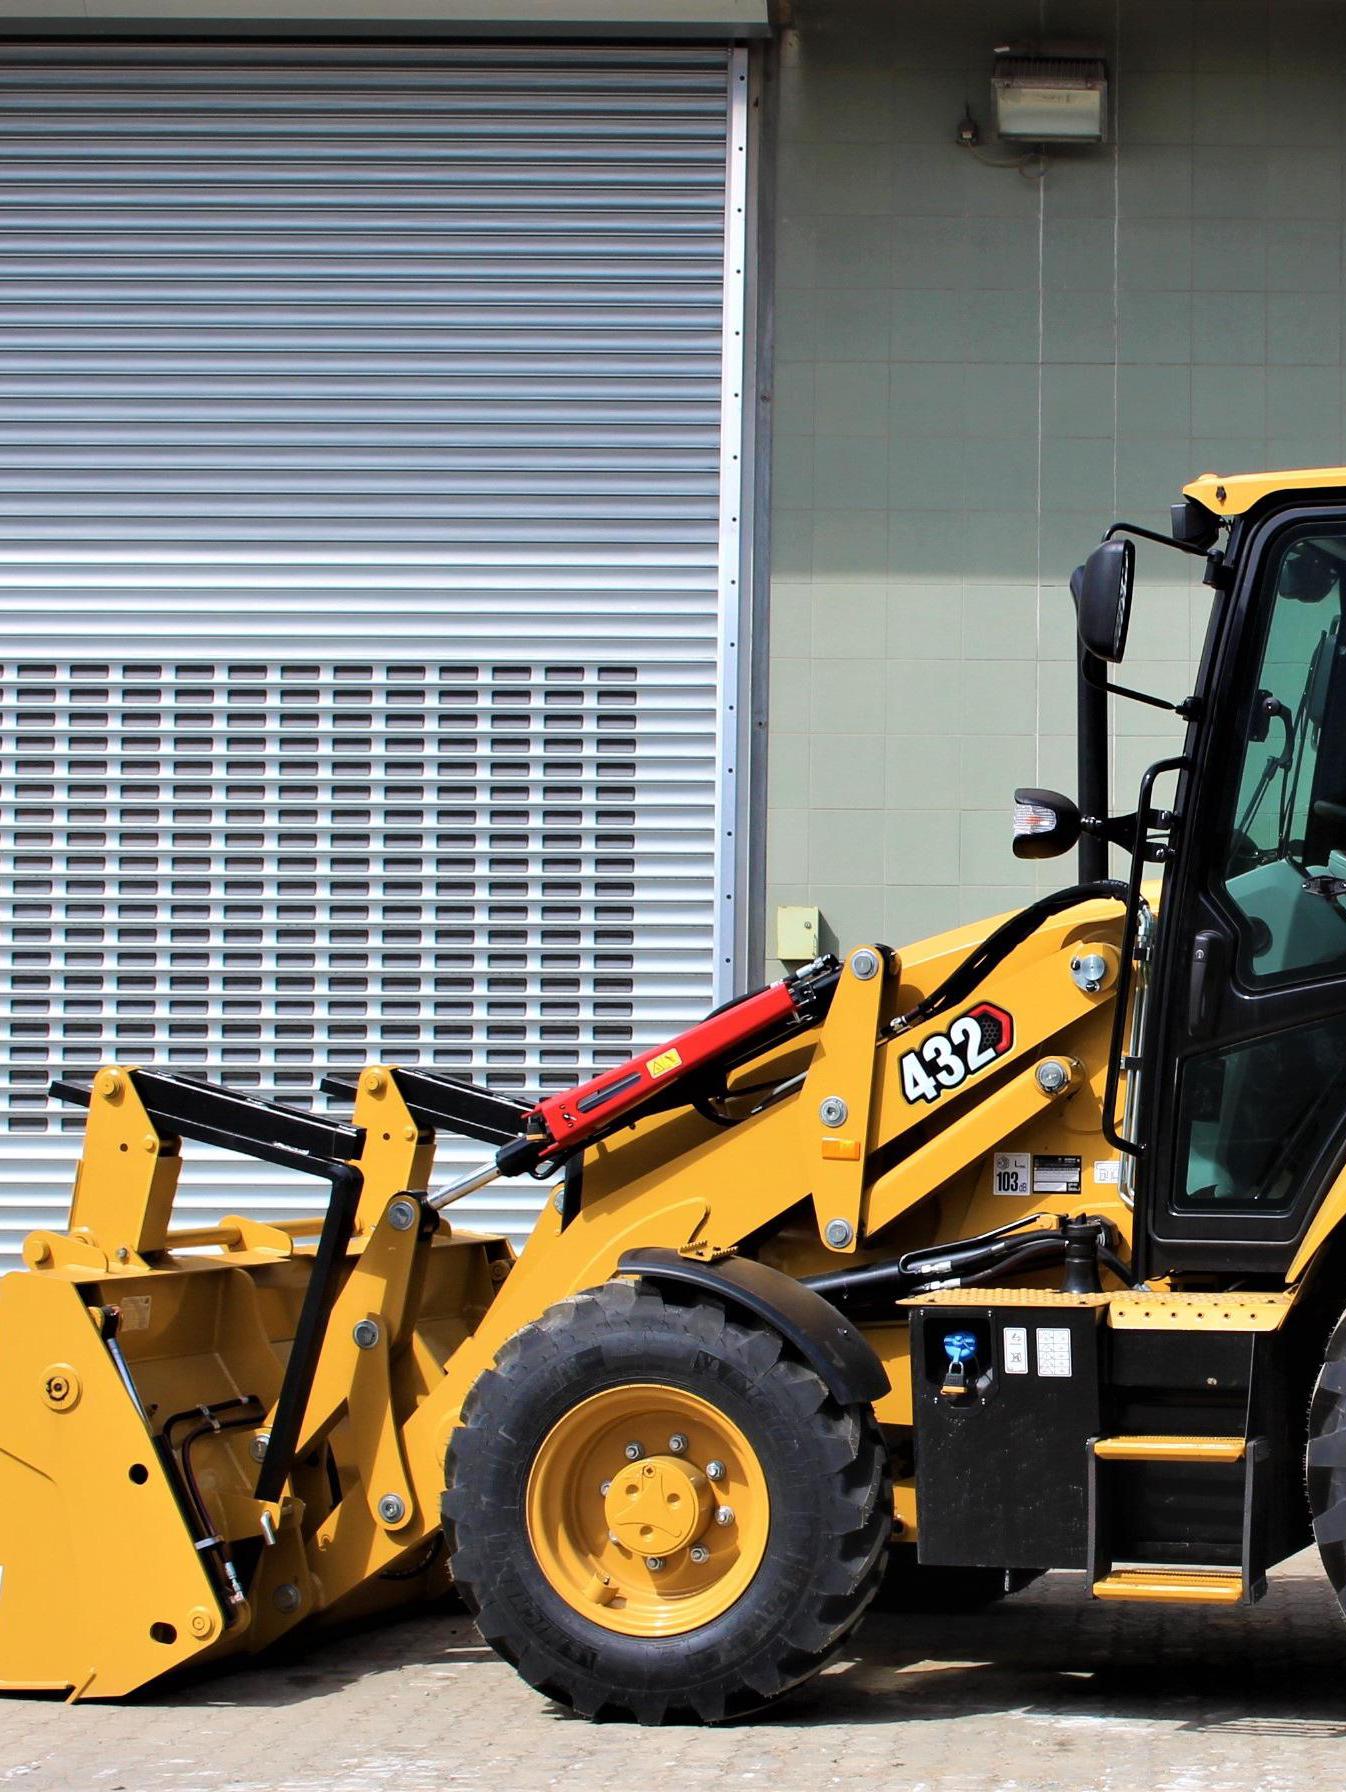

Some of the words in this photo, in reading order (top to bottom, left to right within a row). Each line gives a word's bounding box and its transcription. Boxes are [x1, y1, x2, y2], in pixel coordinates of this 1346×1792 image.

[902, 1017, 996, 1102] 432
[997, 1171, 1018, 1191] 103
[1019, 1182, 1027, 1192] dB
